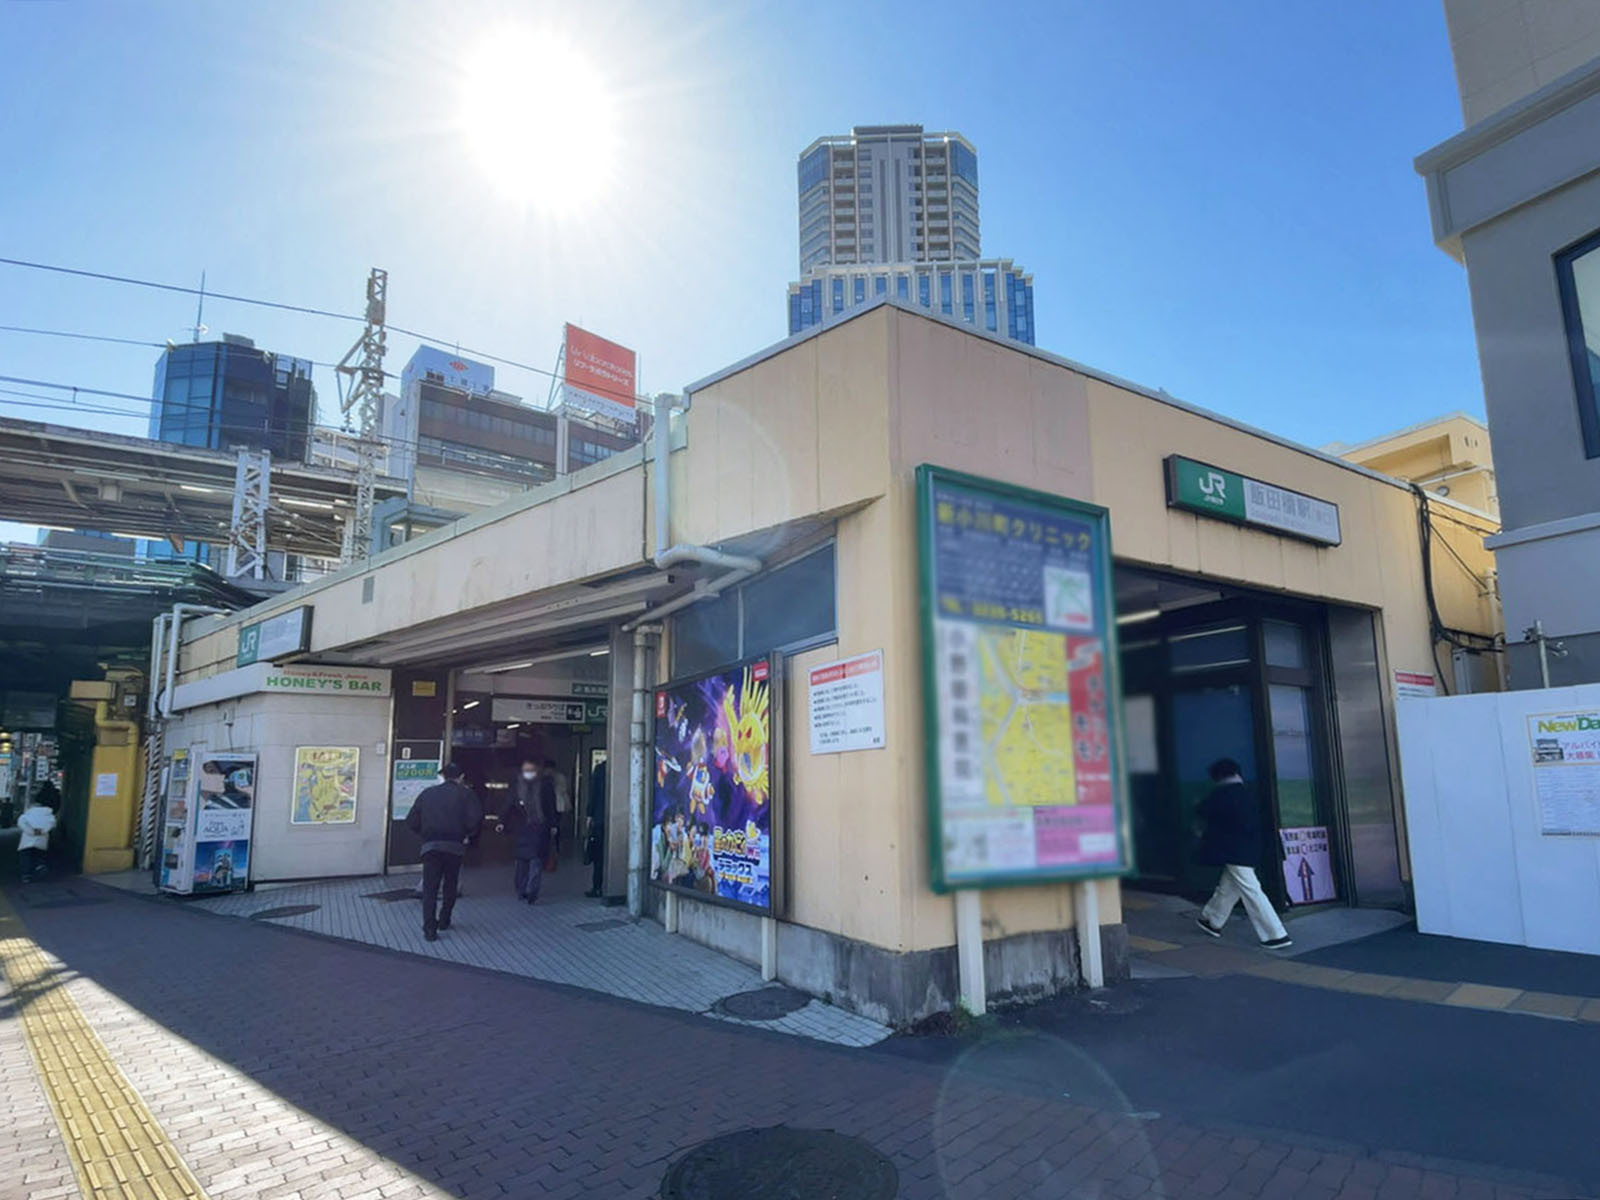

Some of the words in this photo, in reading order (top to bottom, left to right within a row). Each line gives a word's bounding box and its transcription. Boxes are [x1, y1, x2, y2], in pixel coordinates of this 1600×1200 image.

[1199, 472, 1226, 498] JR
[241, 631, 257, 653] JR
[266, 677, 343, 690] HONEY'S
[348, 680, 382, 691] BAR
